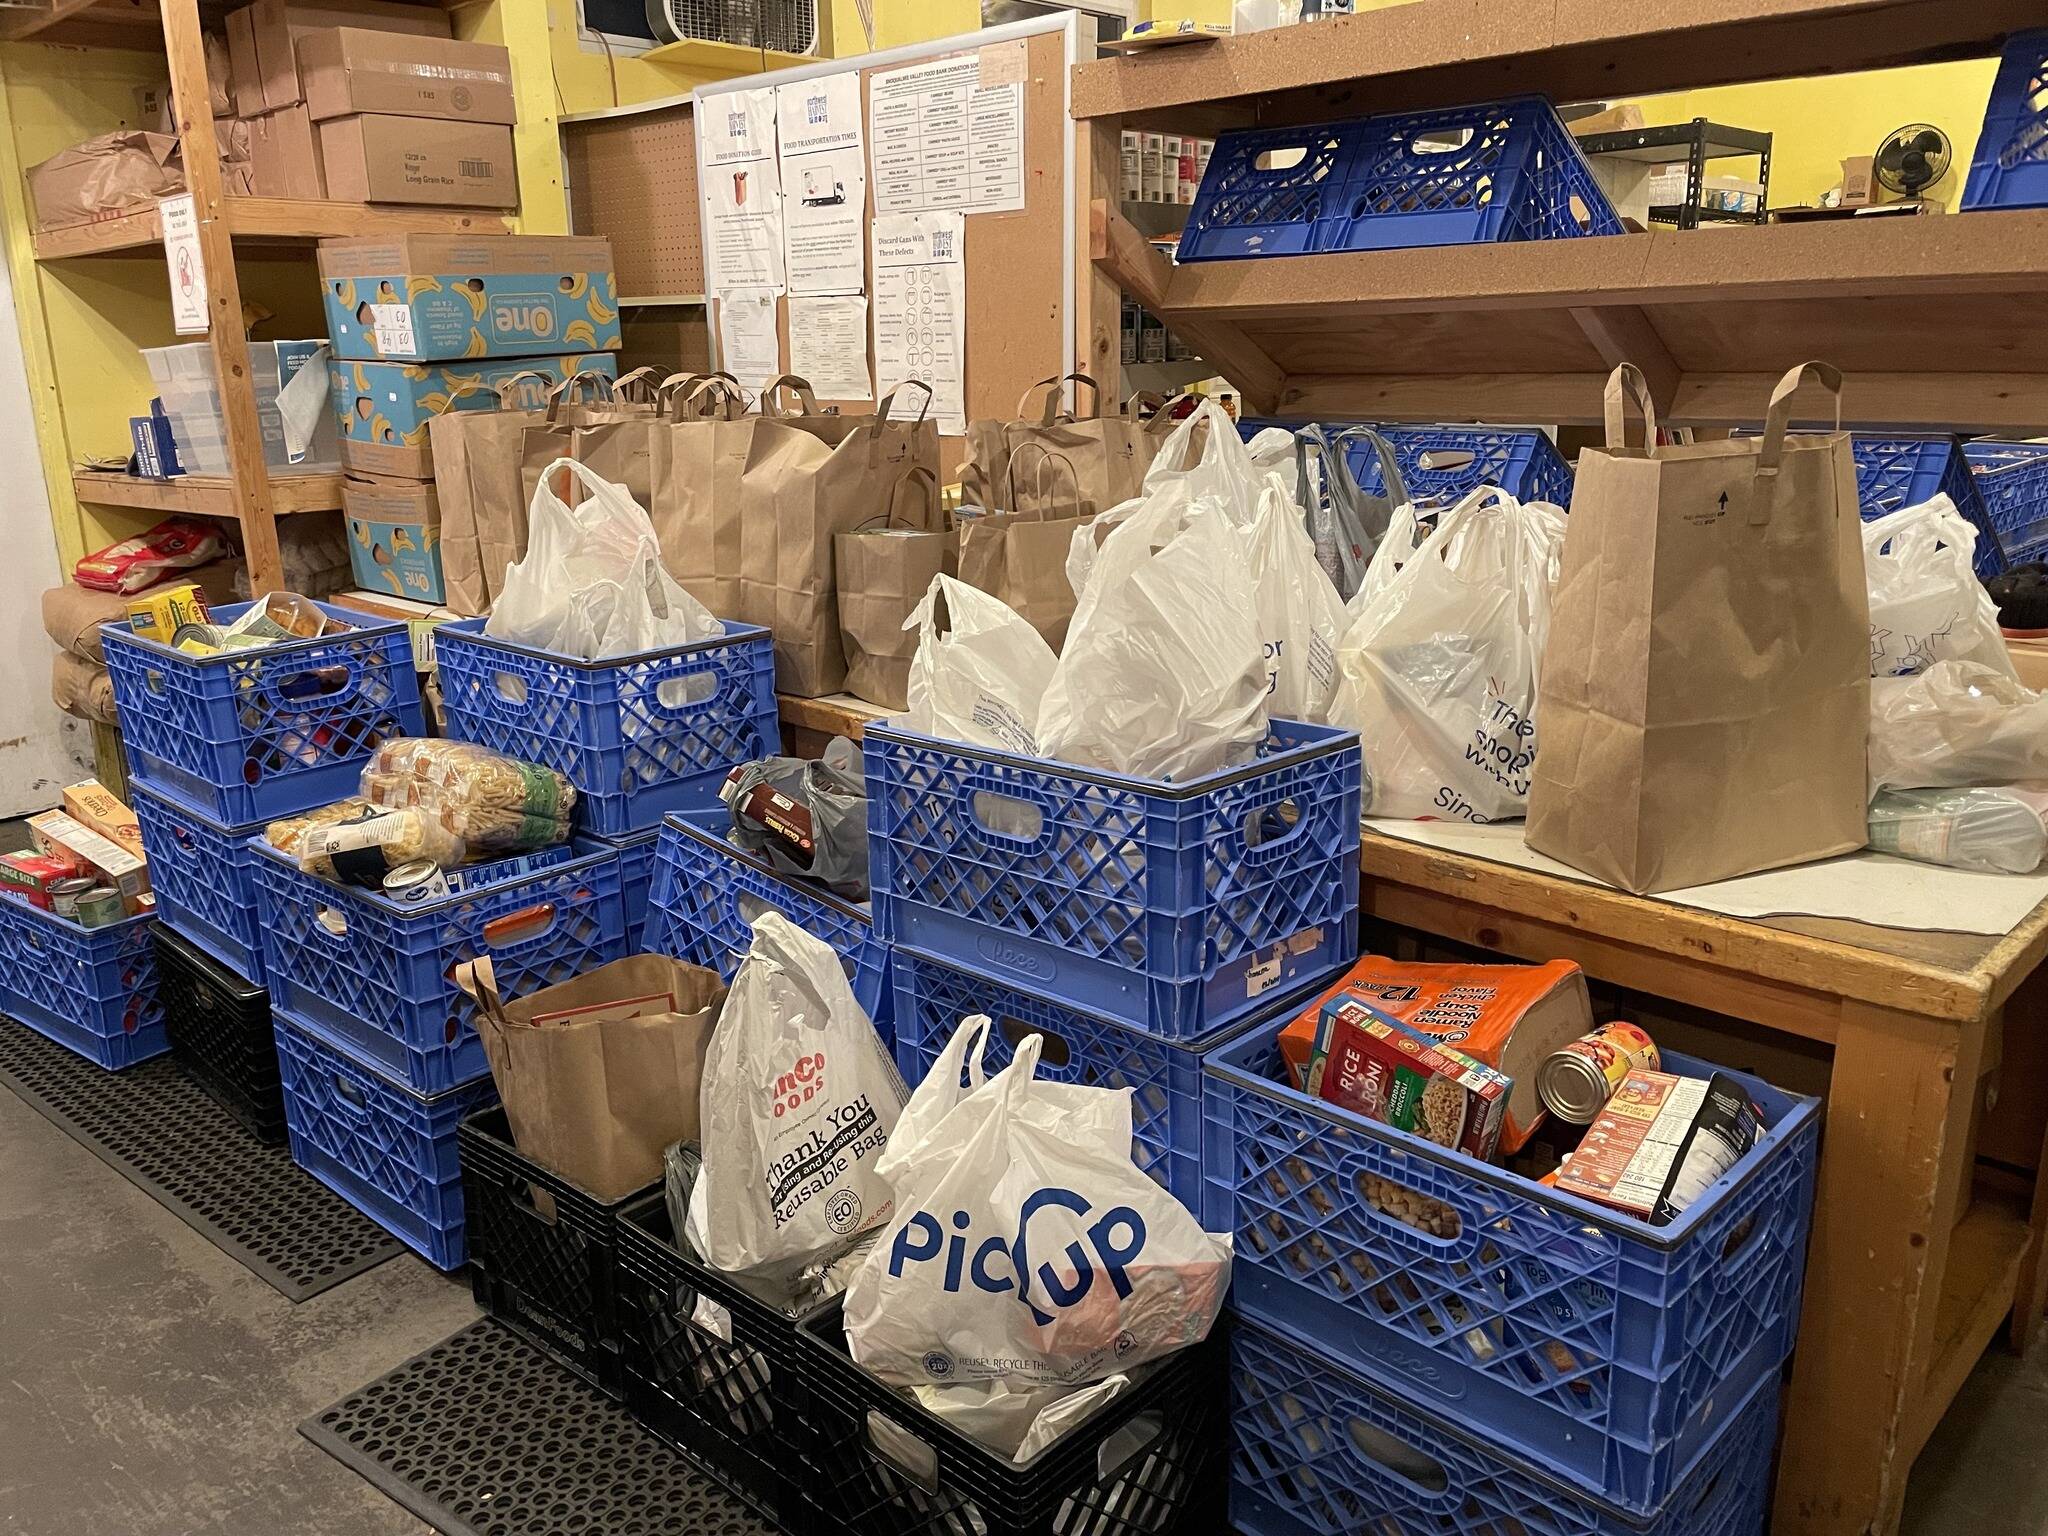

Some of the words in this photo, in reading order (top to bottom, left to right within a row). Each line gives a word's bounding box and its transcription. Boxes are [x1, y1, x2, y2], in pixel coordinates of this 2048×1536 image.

[841, 132, 857, 141] TIMES
[405, 175, 422, 184] Long
[423, 175, 440, 184] Grain
[878, 236, 898, 245] Discard
[912, 234, 925, 242] With
[895, 248, 914, 256] Defects
[495, 306, 554, 337] One
[404, 571, 430, 592] One
[0, 865, 18, 879] ARGE
[20, 873, 35, 886] SIZE
[1377, 985, 1422, 1001] 12
[1419, 1008, 1483, 1020] Noodle
[1436, 1001, 1482, 1011] Soup
[1414, 1017, 1475, 1029] Ramen
[1340, 1048, 1360, 1092] RICE
[774, 1075, 824, 1118] OODS
[1395, 1082, 1408, 1117] BROCCOLI
[766, 1129, 828, 1192] Thank
[826, 1093, 870, 1132] You
[803, 1158, 823, 1175] and
[823, 1127, 858, 1162] Re-Using
[858, 1114, 873, 1130] this
[773, 1157, 849, 1230] Reusable
[850, 1125, 887, 1160] Bag
[834, 1201, 852, 1222] EO
[993, 1358, 1030, 1370] RECYCLE
